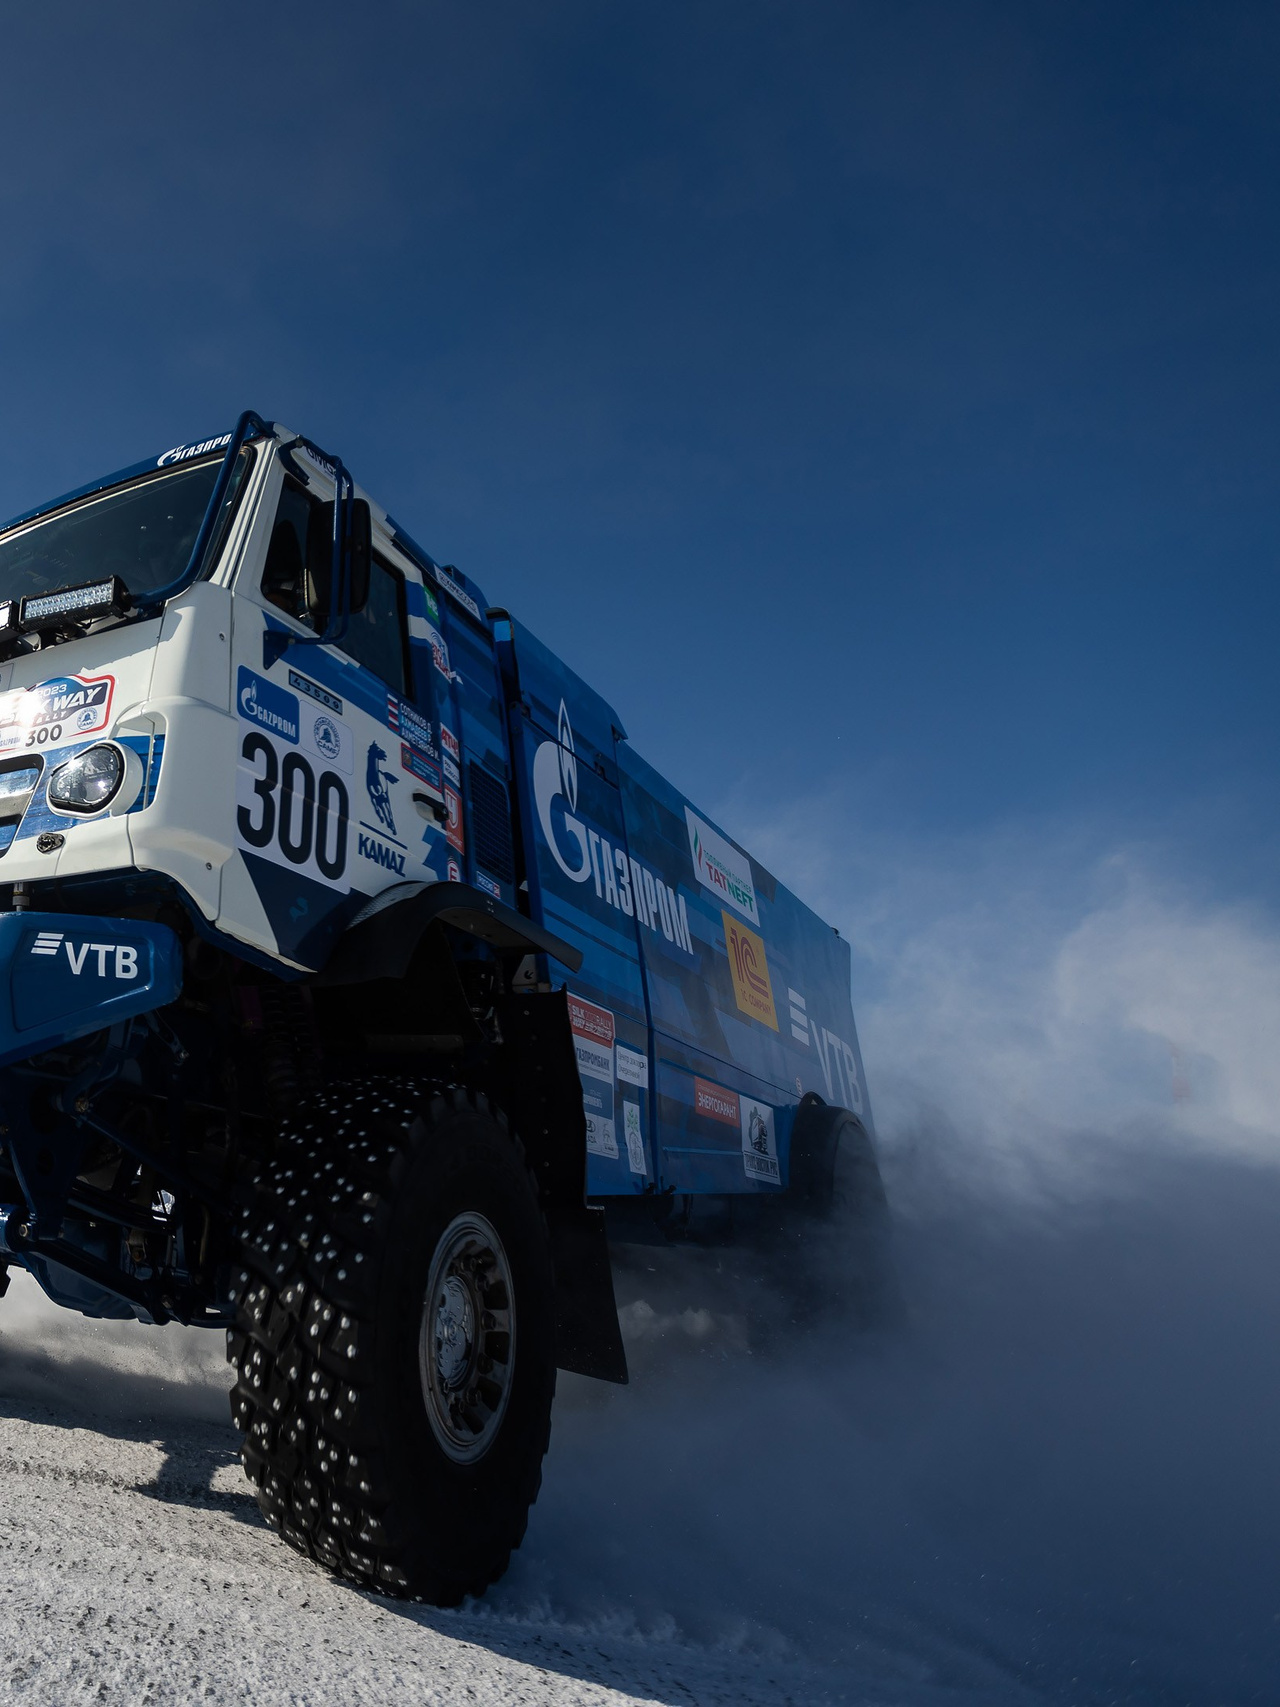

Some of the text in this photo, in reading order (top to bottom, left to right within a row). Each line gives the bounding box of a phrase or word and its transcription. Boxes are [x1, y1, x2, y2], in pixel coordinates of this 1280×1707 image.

[52, 686, 102, 712] WAY
[25, 724, 62, 748] 300
[257, 705, 296, 738] GAZPROM
[236, 731, 350, 881] 300
[358, 832, 406, 878] KAMAZ
[588, 828, 694, 956] ГАЗПРОМ
[705, 861, 754, 913] TATNEFT
[64, 941, 139, 980] VTB
[572, 1004, 585, 1019] SILK
[809, 1018, 864, 1116] VTB
